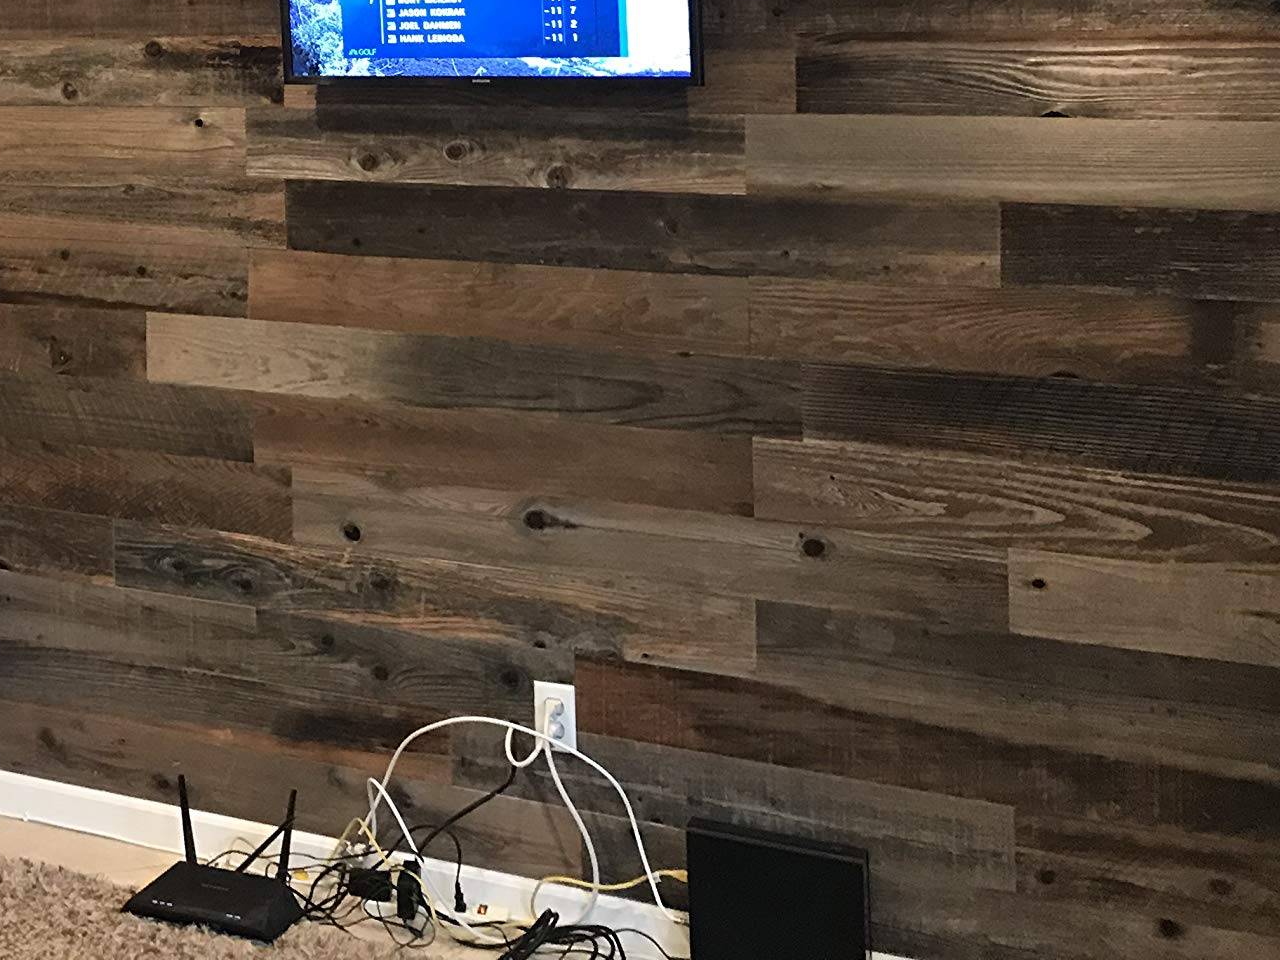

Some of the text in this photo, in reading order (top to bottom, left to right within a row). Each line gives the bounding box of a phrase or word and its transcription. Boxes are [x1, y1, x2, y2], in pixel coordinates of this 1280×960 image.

[399, 8, 426, 17] JASON
[399, 22, 420, 30] JOEL
[545, 20, 562, 28] -11
[358, 48, 377, 56] GOLF
